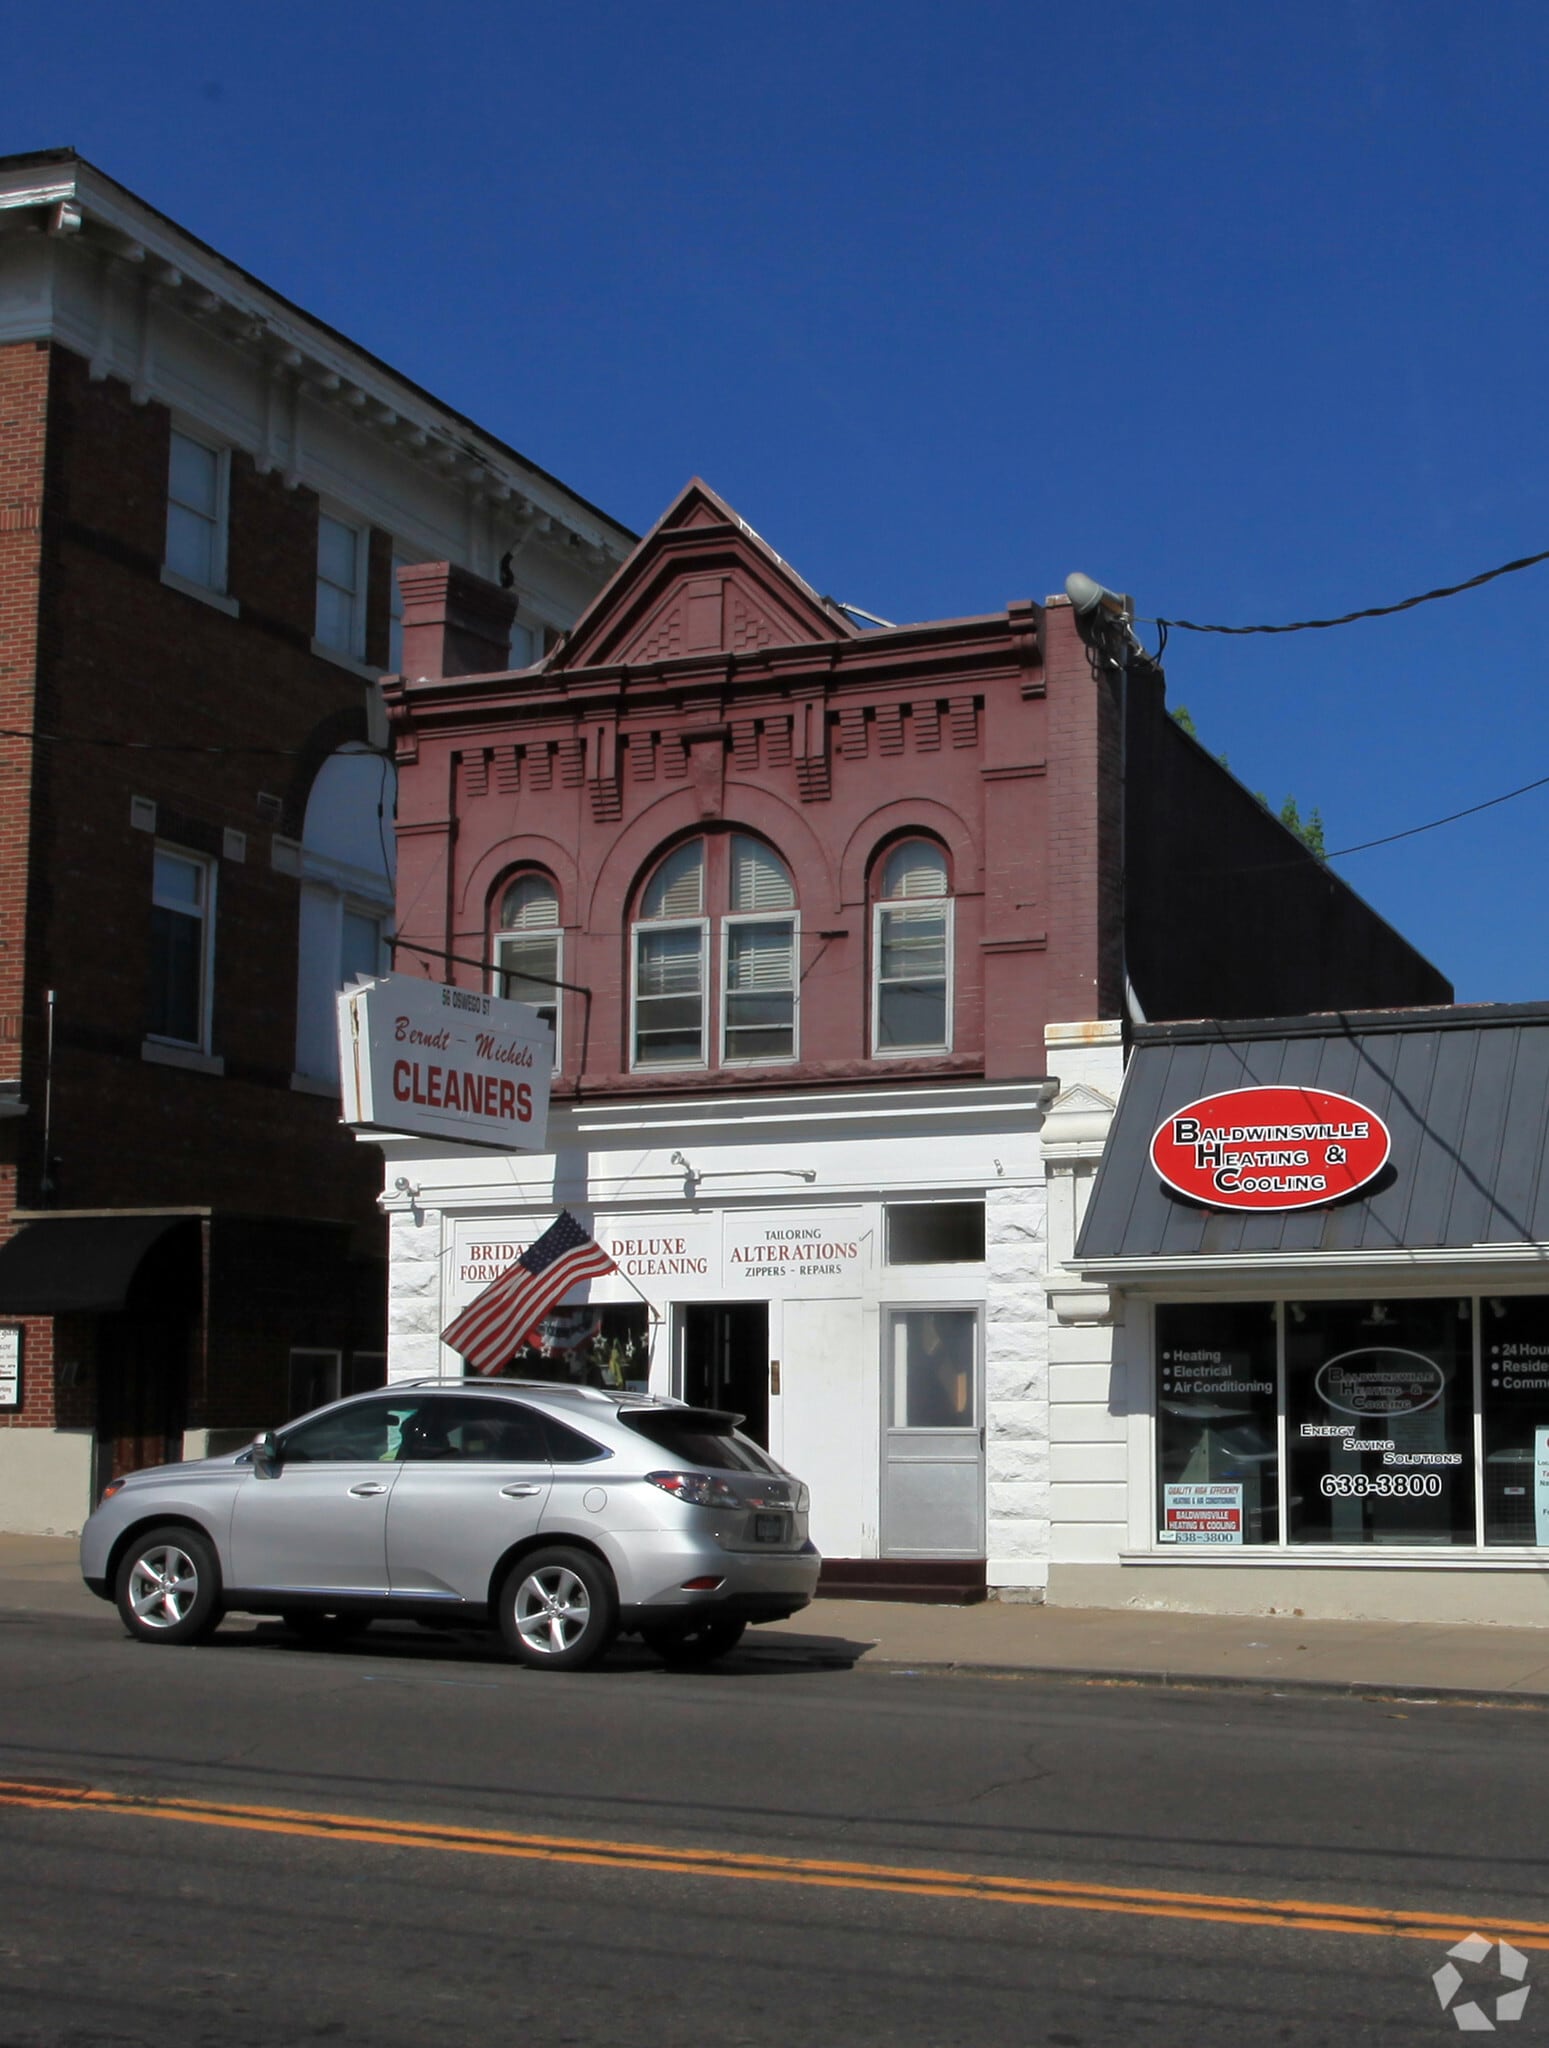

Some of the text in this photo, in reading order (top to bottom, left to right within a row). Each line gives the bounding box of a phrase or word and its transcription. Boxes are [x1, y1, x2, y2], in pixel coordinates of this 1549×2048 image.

[452, 991, 481, 1014] OSWEGO
[482, 998, 490, 1016] ST
[394, 1016, 450, 1051] Berndt
[475, 1032, 533, 1068] Michels
[393, 1059, 532, 1123] CLEANERS
[1174, 1119, 1369, 1144] BALDWINSVILLE
[1196, 1142, 1346, 1169] HEATING &
[1214, 1167, 1327, 1192] COOLING
[764, 1229, 822, 1241] TAILORING
[470, 1244, 526, 1261] BRIDA
[612, 1238, 687, 1256] DELUXE
[730, 1242, 858, 1263] ALTERATIONS
[461, 1264, 506, 1280] FORM
[627, 1258, 708, 1275] CLEANING
[745, 1266, 786, 1278] ZIPPERS
[800, 1264, 842, 1275] REPAIRS
[1174, 1350, 1221, 1363] Heating
[1503, 1344, 1517, 1355] 24
[1174, 1364, 1232, 1377] Electrical
[1174, 1380, 1273, 1394] Air Conditioning
[1503, 1377, 1549, 1389] Comm
[1300, 1424, 1355, 1437] ENERGY
[1343, 1438, 1395, 1451] SAVING
[1383, 1452, 1462, 1465] SOLUTIONS
[1168, 1486, 1192, 1495] QUALITY
[1321, 1474, 1442, 1497] 638-3800
[1176, 1511, 1229, 1520] BALDWINSVILLE
[1169, 1521, 1197, 1530] HEATING
[1206, 1521, 1236, 1530] COOLING
